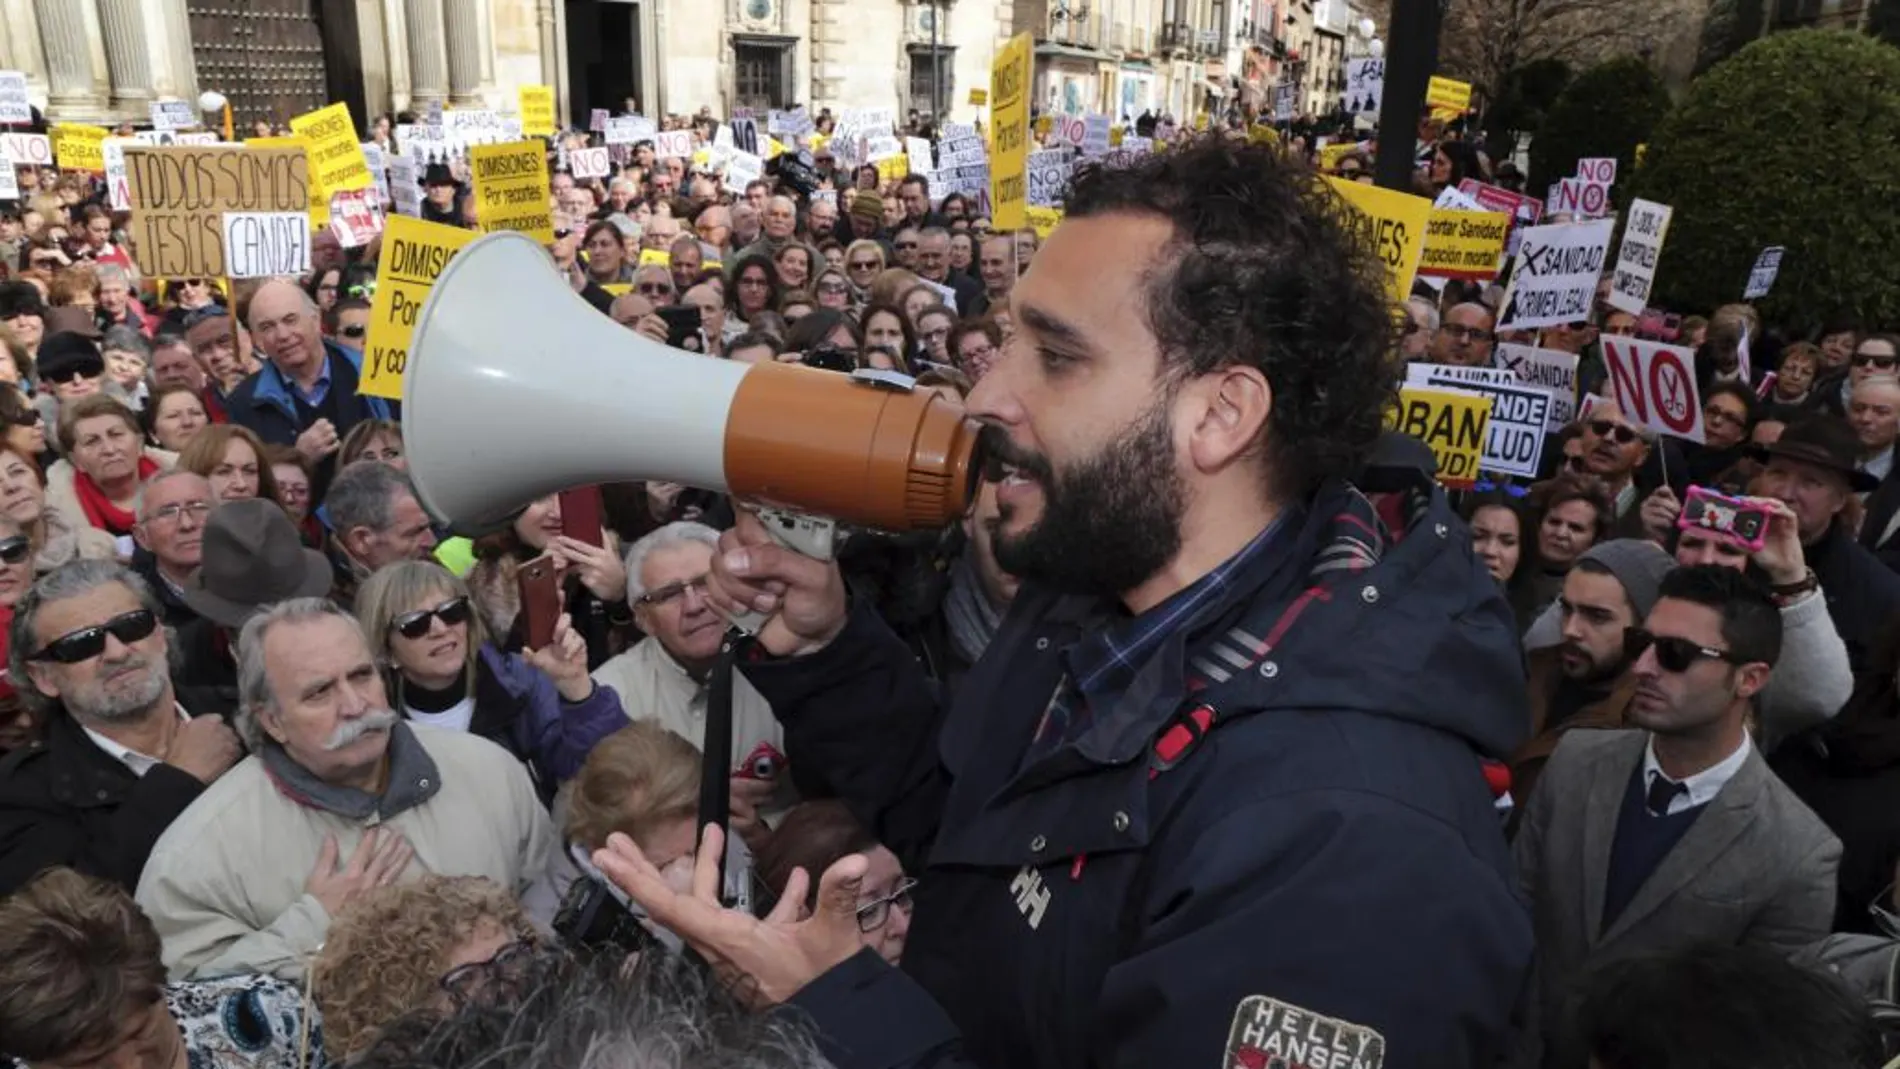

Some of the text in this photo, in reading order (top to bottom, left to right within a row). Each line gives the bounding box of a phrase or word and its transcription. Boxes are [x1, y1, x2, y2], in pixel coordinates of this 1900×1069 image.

[9, 136, 49, 161] NO
[659, 134, 689, 152] NO
[731, 120, 758, 155] NO
[571, 151, 607, 175] NO
[1029, 168, 1060, 190] NO
[1581, 159, 1613, 182] NO
[125, 152, 215, 211] TODOS
[219, 151, 308, 210] SOMOS
[1559, 179, 1604, 213] NO
[229, 215, 310, 276] CANDEL
[1541, 245, 1603, 276] SANIDAD
[389, 290, 421, 326] Por
[1604, 341, 1696, 434] NO
[1490, 391, 1544, 427] NDE
[1482, 427, 1536, 464] LUD
[1256, 1000, 1373, 1060] HELLY
